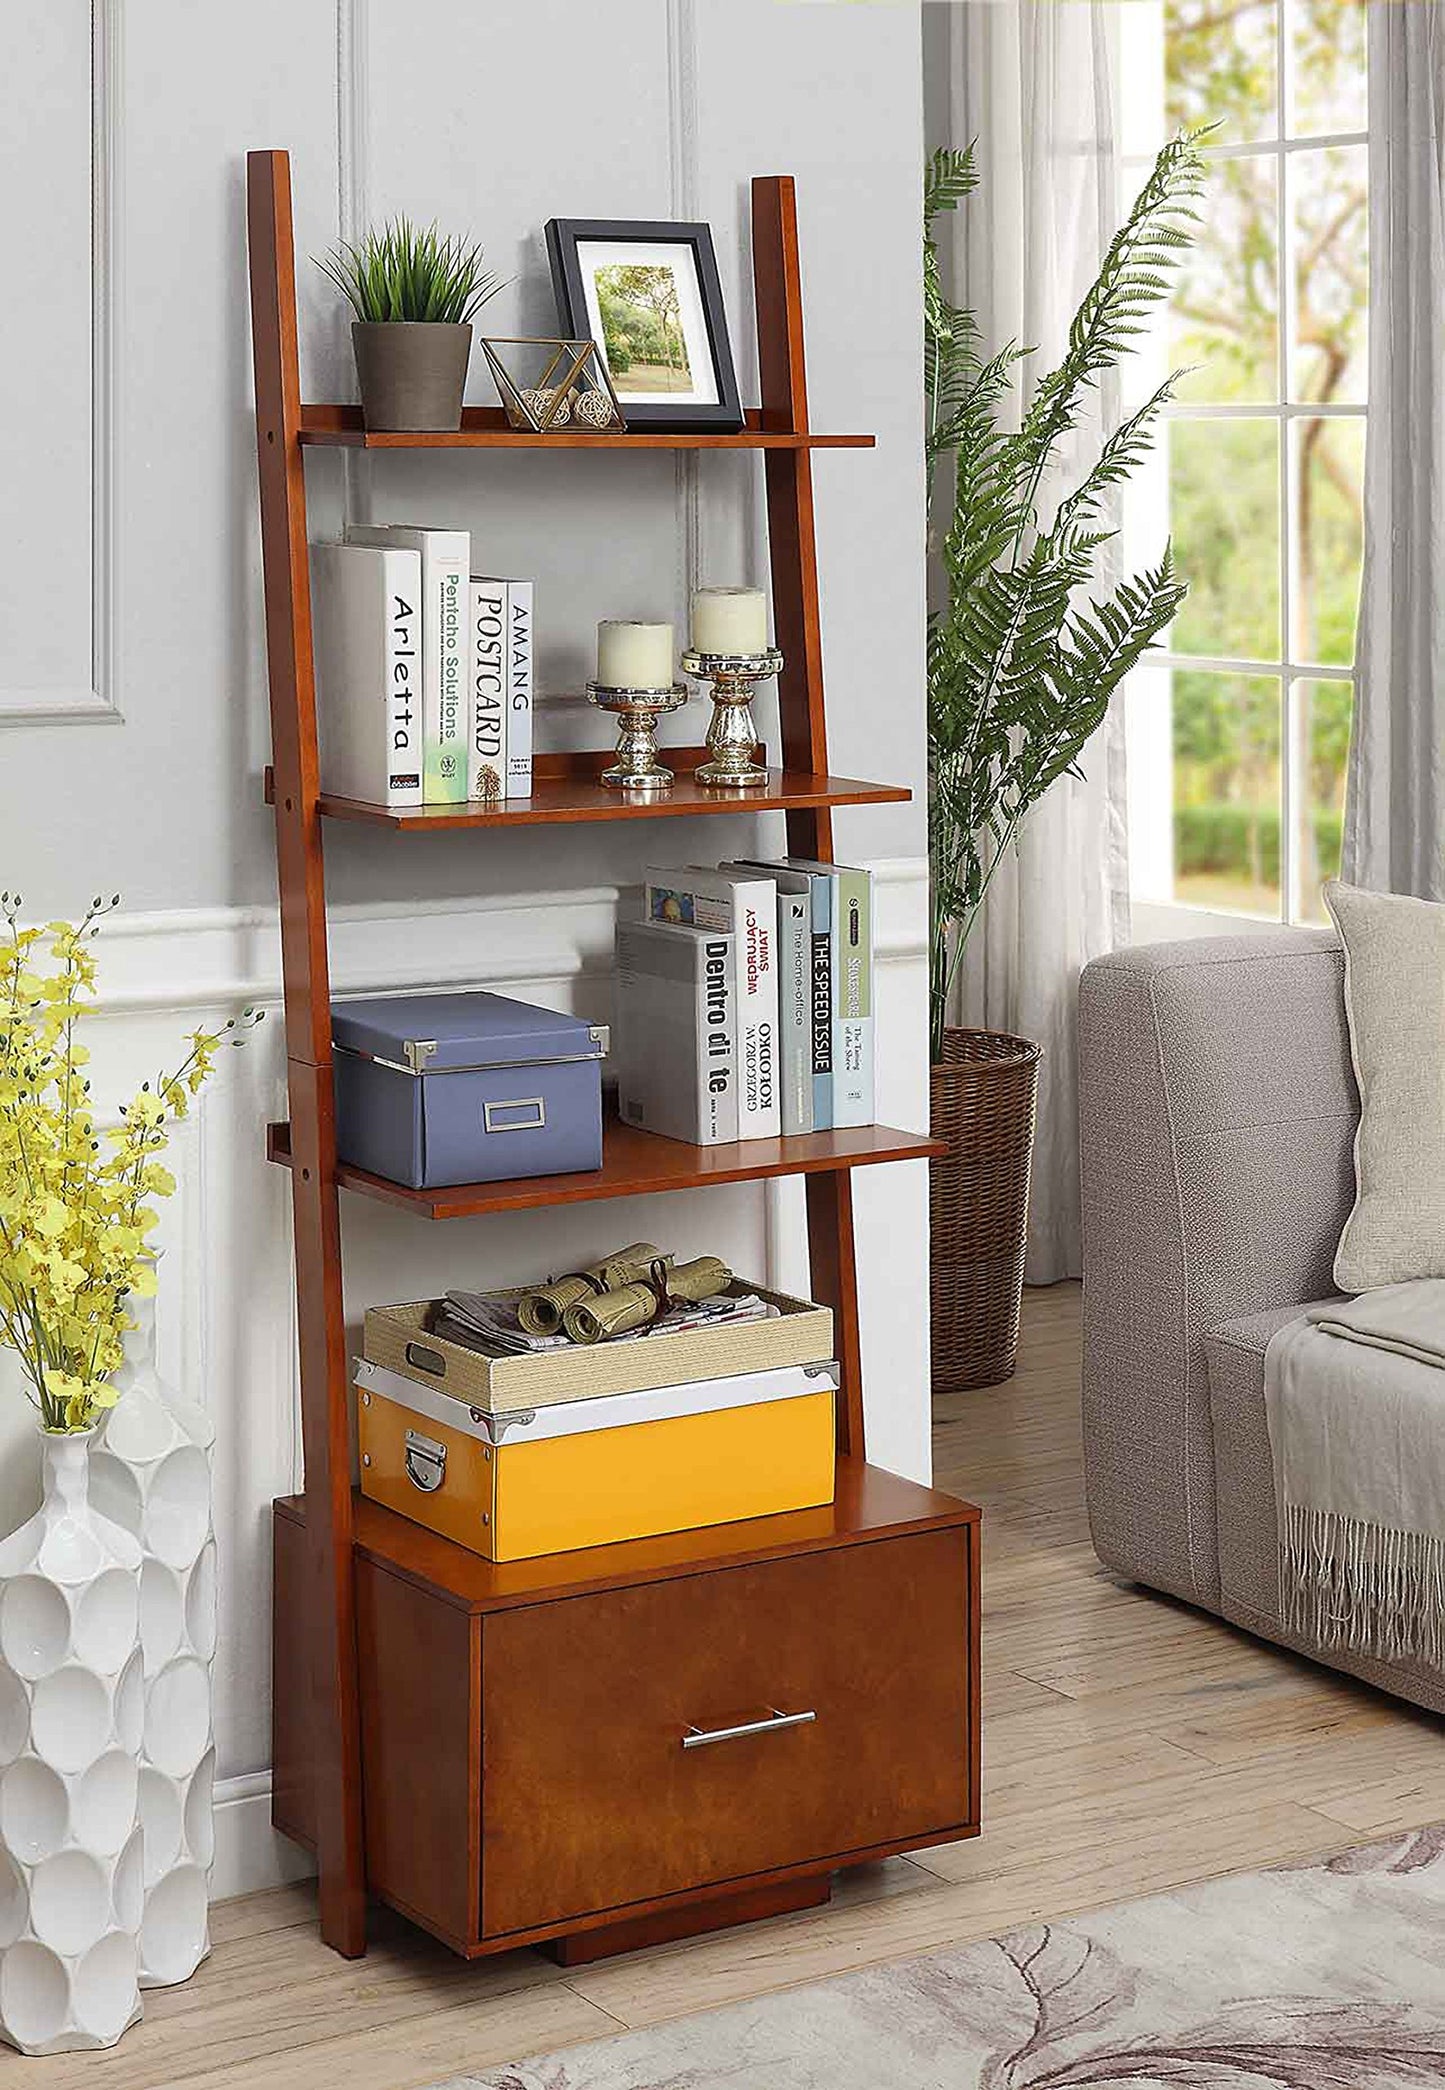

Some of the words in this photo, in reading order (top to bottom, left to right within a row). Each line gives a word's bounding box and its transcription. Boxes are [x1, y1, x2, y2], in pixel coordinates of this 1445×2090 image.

[446, 574, 459, 650] Pentaho
[393, 594, 414, 751] Arletta
[476, 594, 503, 757] POSTCARD
[512, 605, 529, 711] AMANG
[445, 656, 459, 740] Solutions
[746, 908, 758, 995] WĘDRUJĄCY
[758, 928, 769, 972] ŚWIAT
[794, 928, 803, 949] The
[814, 937, 829, 967] THE
[705, 940, 728, 1025] Dentro
[814, 971, 829, 1020] SPEED
[707, 1033, 730, 1058] di
[758, 1022, 772, 1110] KOŁODKO
[814, 1023, 830, 1070] ISSUE
[854, 1026, 862, 1042] The
[708, 1068, 730, 1093] te
[746, 1041, 758, 1112] GRZEGORZ
